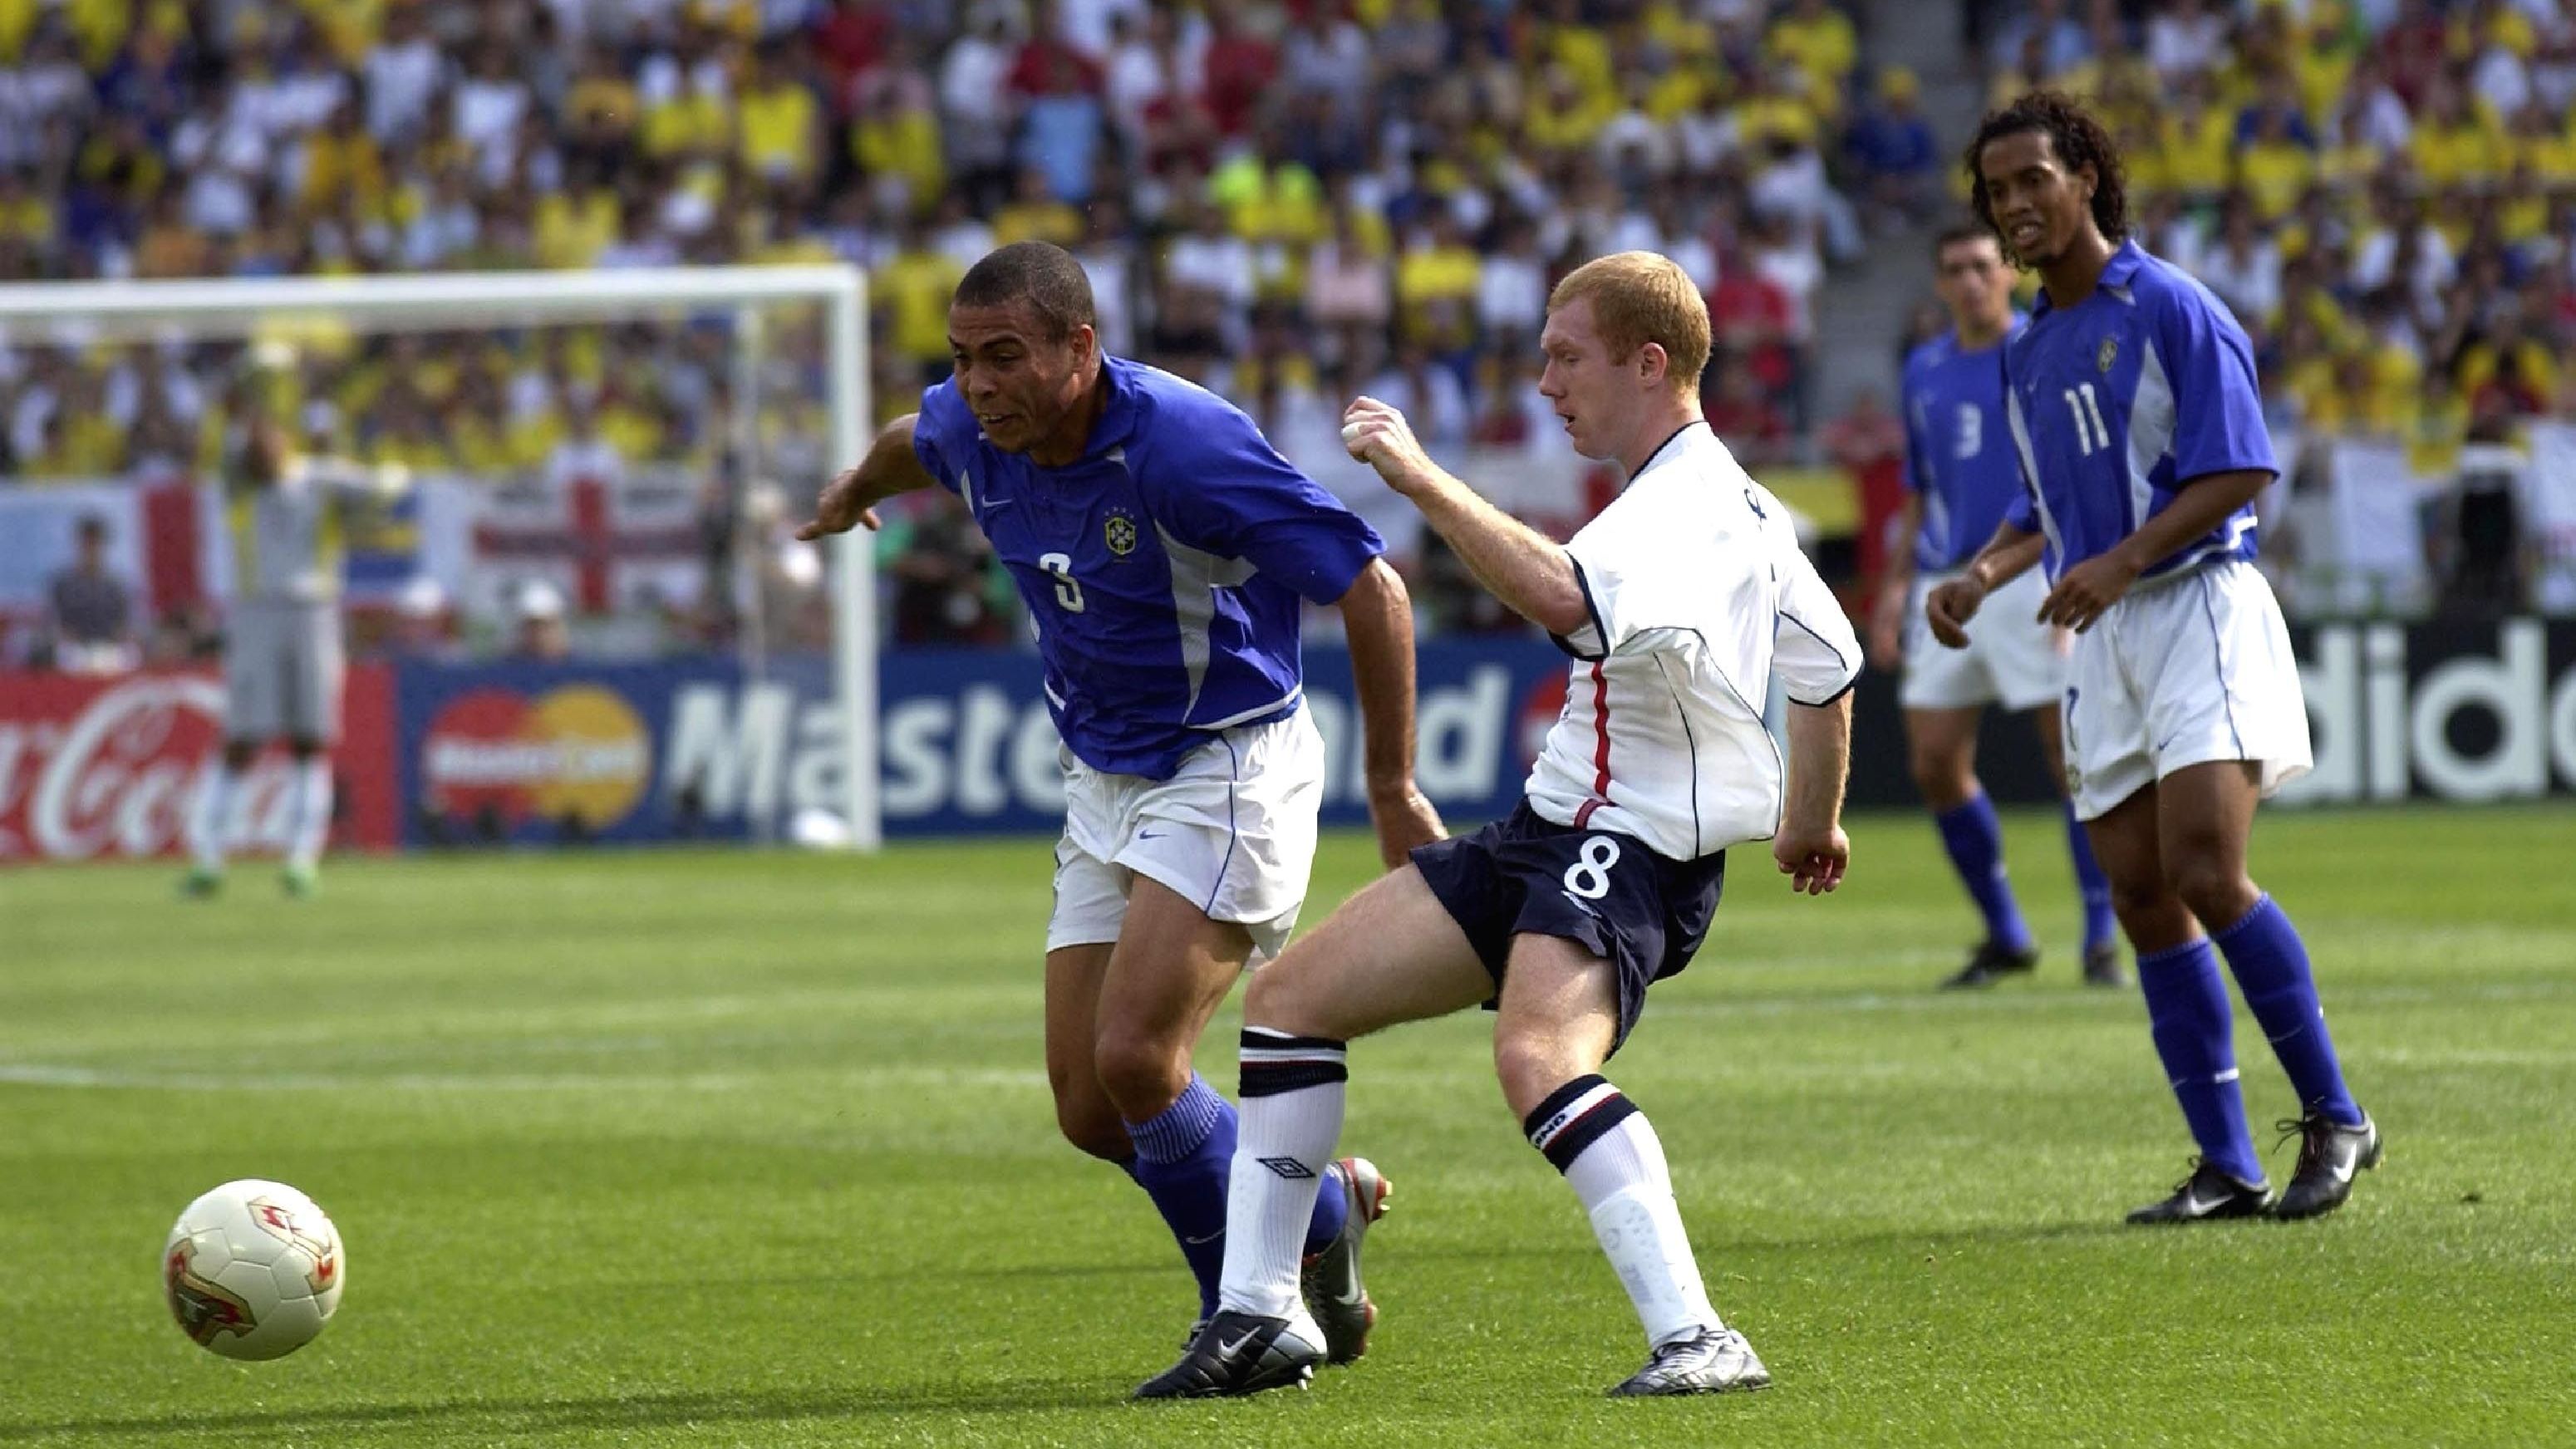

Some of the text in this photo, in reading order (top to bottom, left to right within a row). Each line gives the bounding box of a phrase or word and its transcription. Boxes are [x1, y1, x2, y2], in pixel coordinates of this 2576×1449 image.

[2065, 382, 2111, 456] 11
[1040, 553, 1084, 613] 3
[1564, 835, 1620, 899] 8
